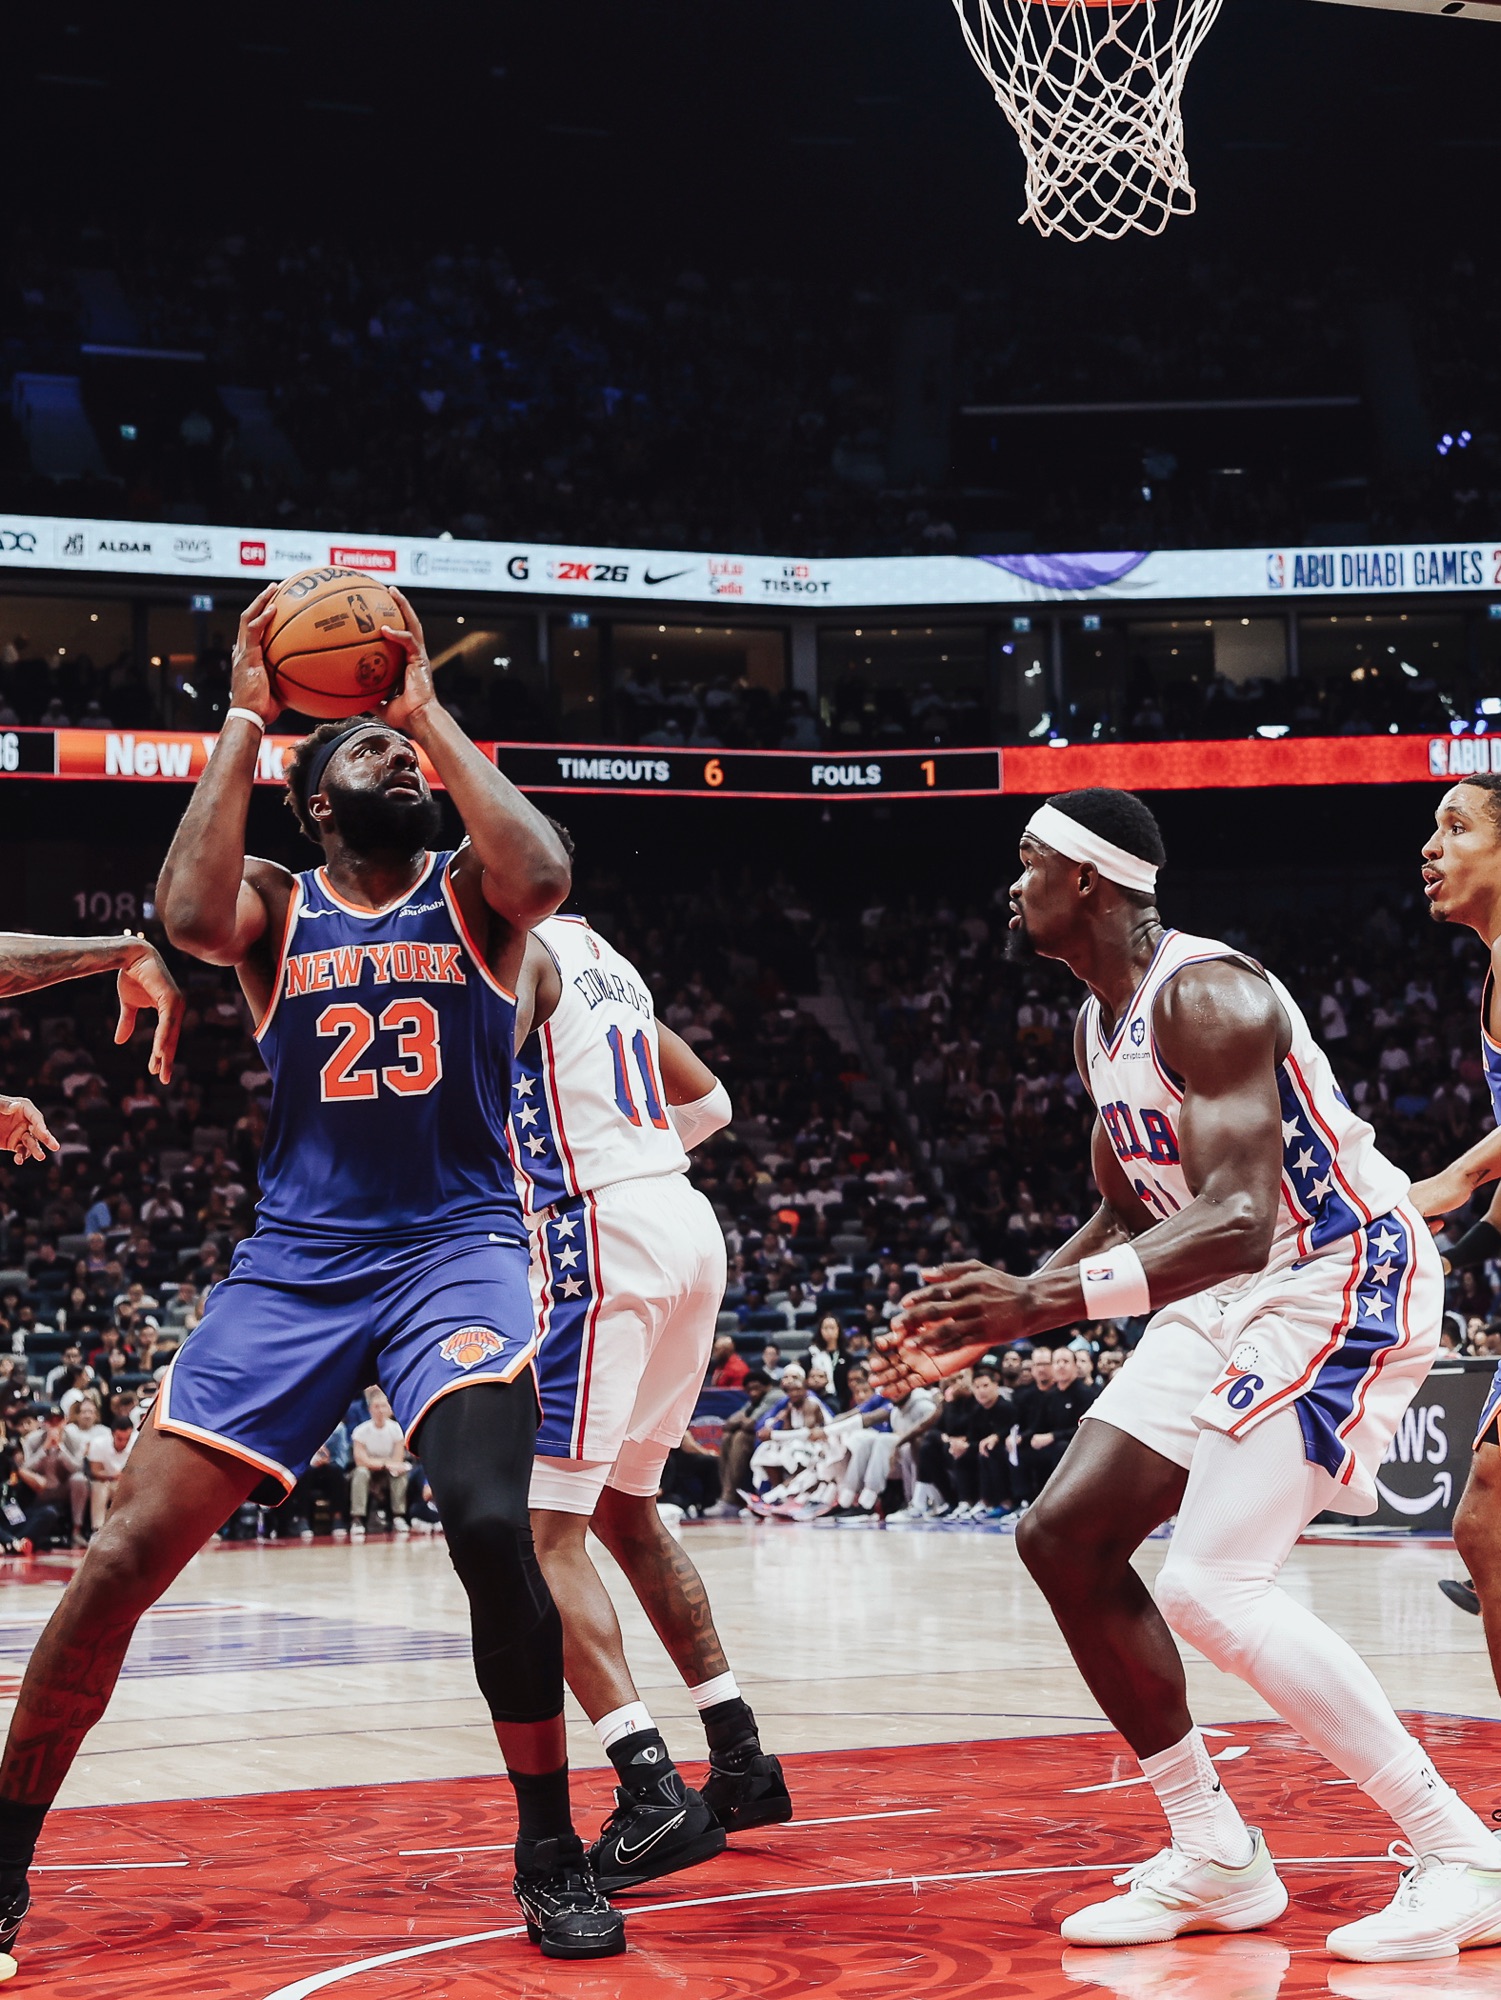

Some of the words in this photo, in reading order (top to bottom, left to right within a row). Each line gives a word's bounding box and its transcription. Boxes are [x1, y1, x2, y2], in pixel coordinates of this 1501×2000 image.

[334, 551, 391, 568] Emirates
[557, 562, 629, 582] 2K26
[1293, 555, 1334, 588] ABU
[1341, 553, 1404, 587] DHABI
[1414, 551, 1483, 585] GAMES
[762, 580, 832, 594] TISSOT
[0, 732, 19, 771] 6
[105, 734, 193, 777] New
[202, 736, 285, 780] Yk
[1449, 738, 1490, 775] ABU
[557, 757, 670, 782] TIMEOUTS
[704, 758, 723, 787] 6
[811, 765, 882, 787] FOULS
[920, 759, 935, 787] 1
[285, 945, 363, 999] NEW
[366, 940, 466, 985] YORK
[573, 968, 650, 1020] EDWARDS
[315, 997, 443, 1103] 23
[606, 1024, 670, 1130] 11
[1210, 1361, 1264, 1410] 76
